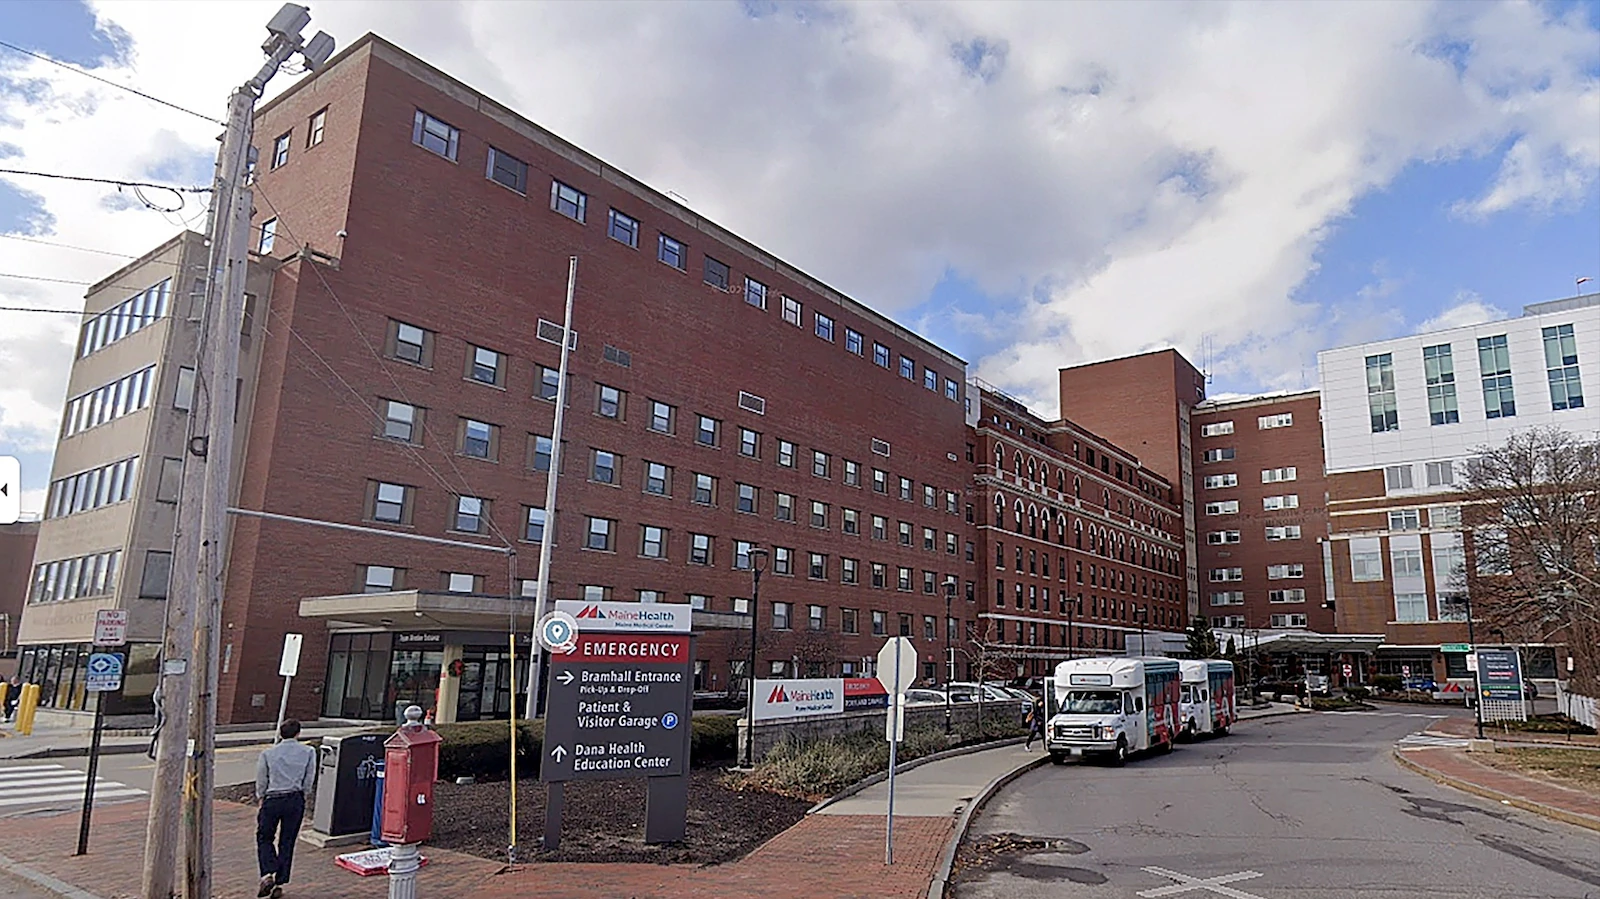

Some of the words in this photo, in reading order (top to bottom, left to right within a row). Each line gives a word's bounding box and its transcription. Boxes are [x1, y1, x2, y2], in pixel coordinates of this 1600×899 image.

[608, 610, 674, 621] MaineHealth
[584, 642, 680, 656] EMERGENCY
[581, 671, 632, 682] Bramhall
[635, 671, 681, 682] Entrance
[580, 685, 608, 695] Pick-Up
[617, 685, 649, 694] Drop-Off
[790, 689, 834, 701] MaineHealth
[579, 701, 620, 713] Patient
[622, 701, 631, 713] &
[577, 716, 615, 728] Visitor
[618, 715, 658, 729] Garage
[575, 744, 605, 756] Dana
[609, 742, 645, 754] Health
[574, 758, 631, 771] Education
[634, 756, 671, 769] Center
